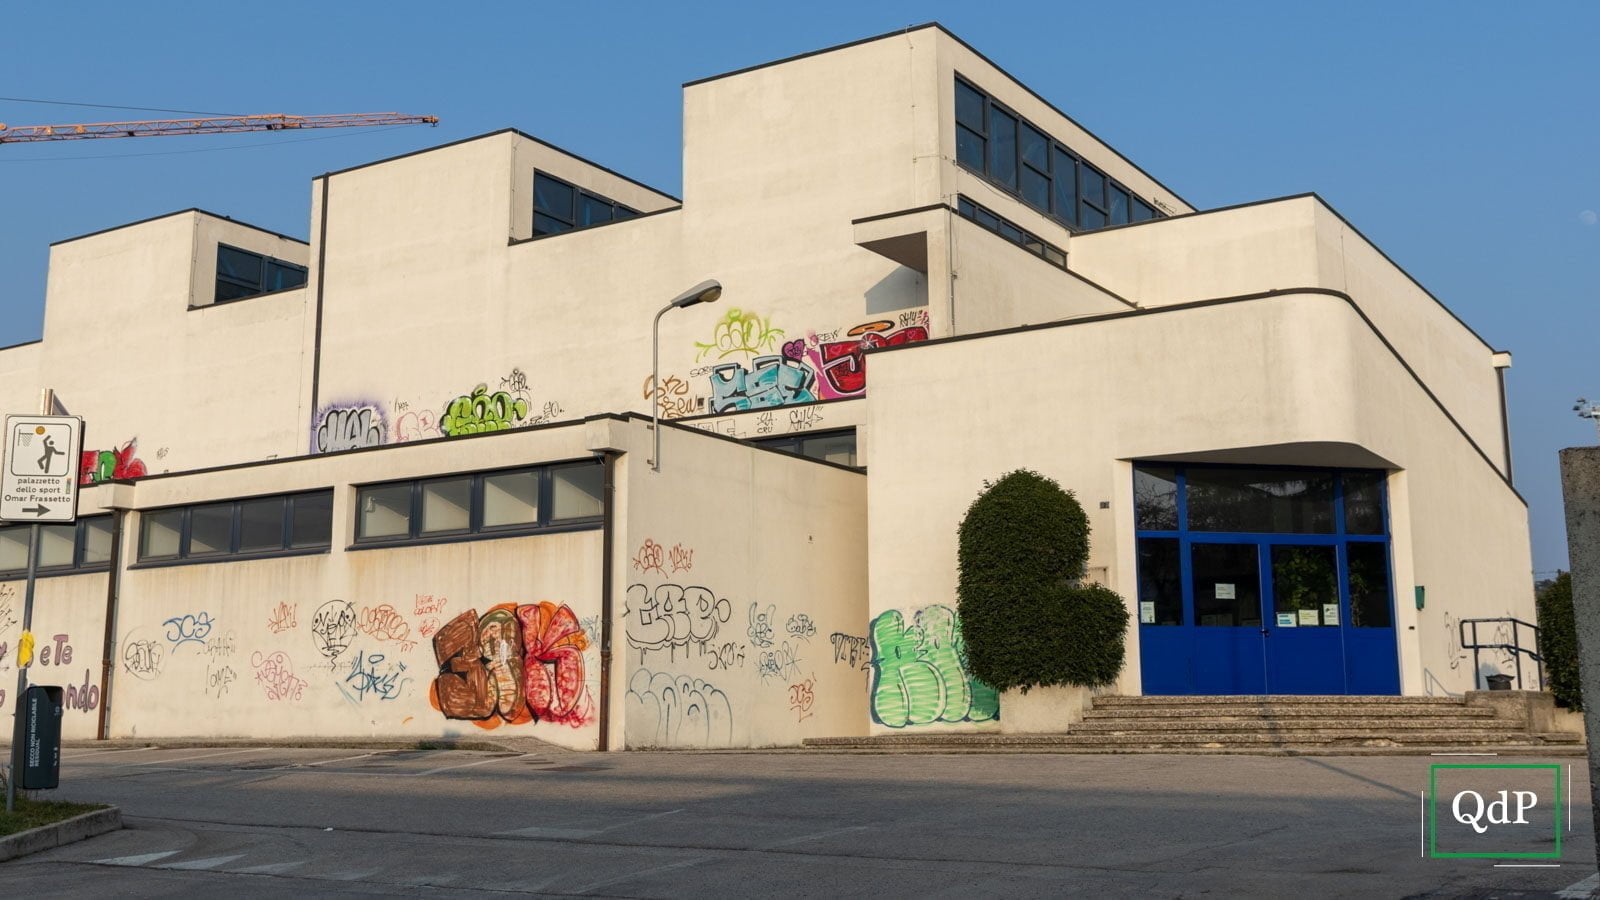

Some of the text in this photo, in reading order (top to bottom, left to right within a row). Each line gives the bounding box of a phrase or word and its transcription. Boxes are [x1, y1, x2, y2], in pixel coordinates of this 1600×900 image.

[17, 477, 60, 485] palazzetto
[4, 494, 71, 502] Omar Frassetto
[62, 668, 100, 713] ndo
